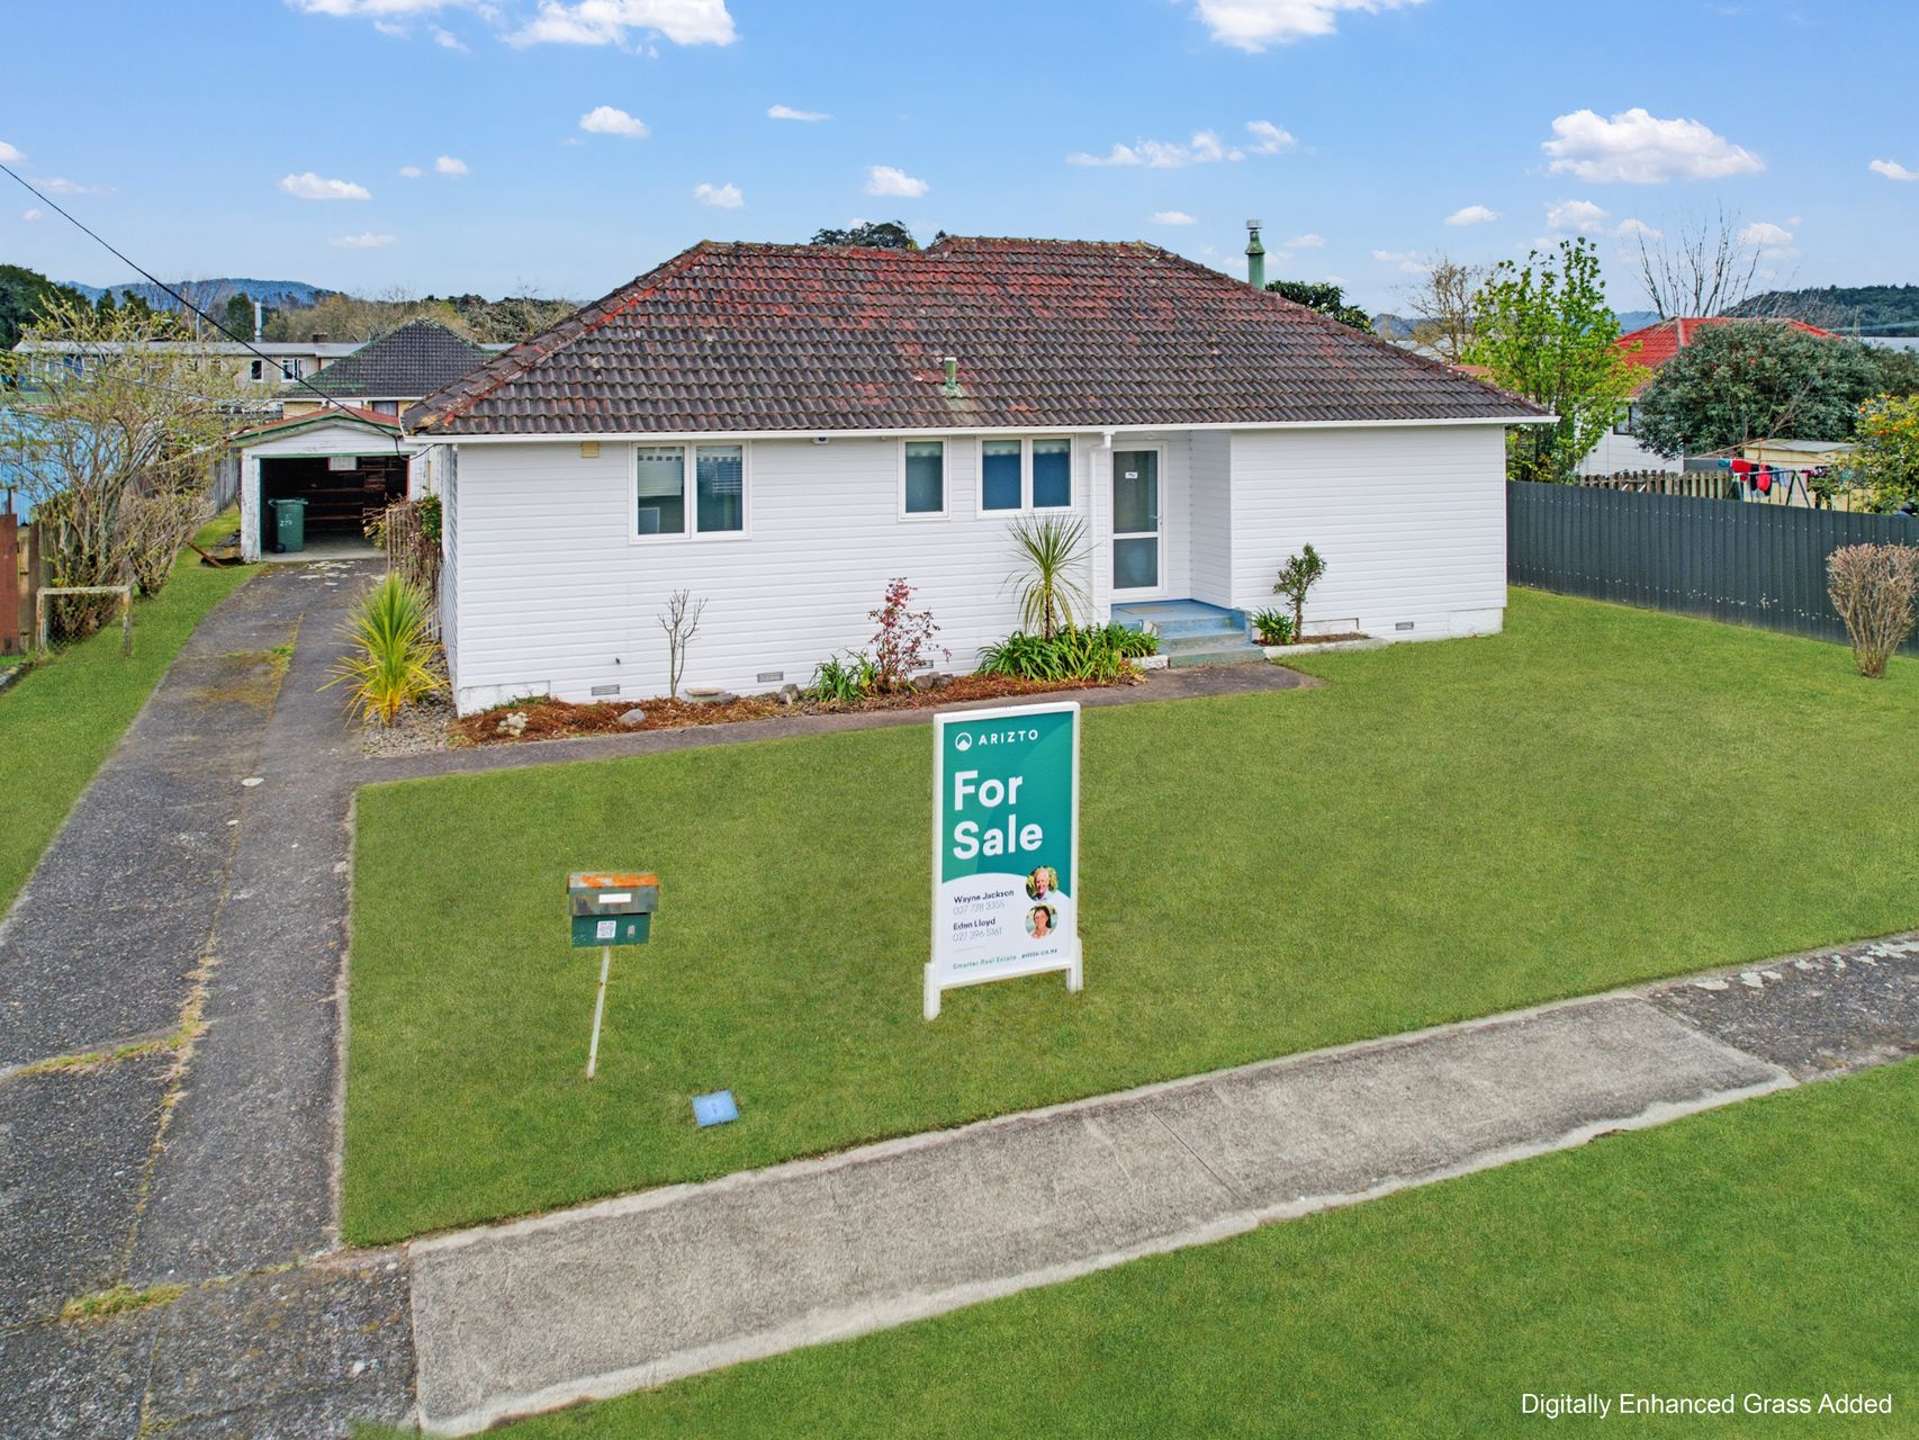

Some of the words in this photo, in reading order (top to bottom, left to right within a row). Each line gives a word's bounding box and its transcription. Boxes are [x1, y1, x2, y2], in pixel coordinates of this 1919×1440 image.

[978, 729, 1039, 746] ARIZTO
[954, 769, 1024, 811] For
[953, 814, 1044, 860] Sale
[953, 895, 981, 904] Wayne
[982, 890, 1015, 900] Jackson
[973, 917, 996, 928] Lloyd
